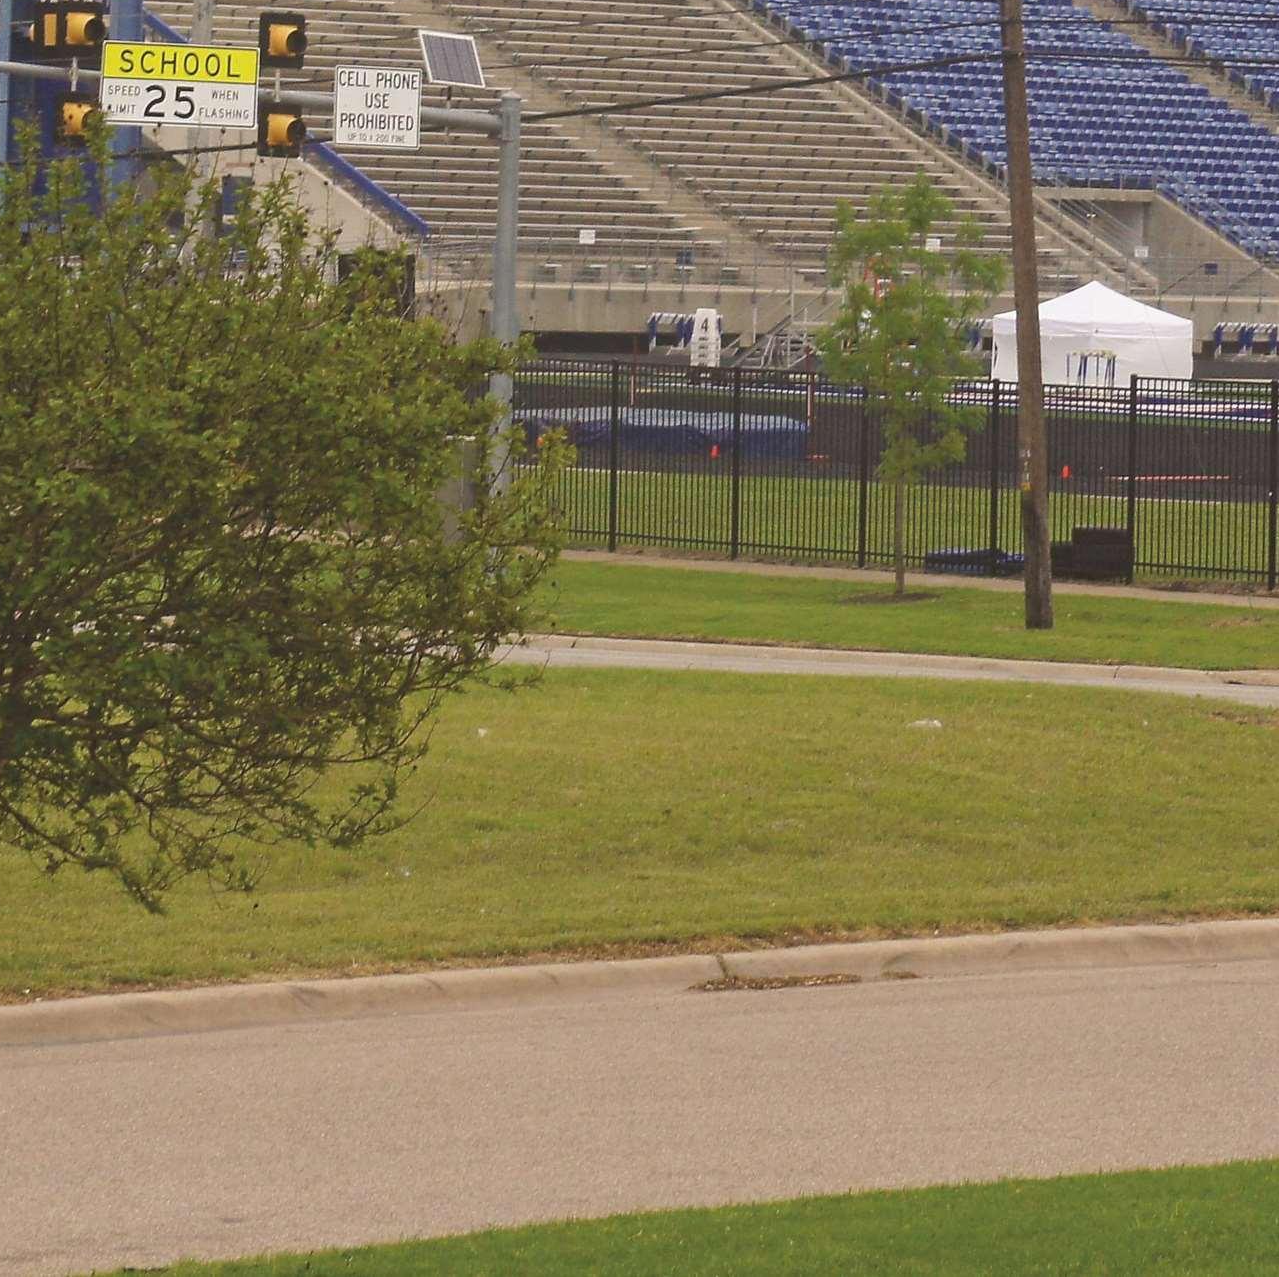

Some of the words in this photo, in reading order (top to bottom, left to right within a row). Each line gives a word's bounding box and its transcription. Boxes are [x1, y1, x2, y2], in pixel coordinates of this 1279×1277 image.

[120, 49, 241, 78] SCHOOL
[339, 70, 371, 88] CELL
[376, 72, 418, 90] PHONE
[108, 85, 141, 96] SPEED
[211, 89, 239, 100] WHEN
[144, 84, 195, 119] 25
[365, 92, 390, 109] USE
[108, 104, 137, 115] LIMIT
[199, 107, 250, 120] FLASHING
[340, 112, 414, 131] PROHIBITED
[701, 317, 709, 332] 4
